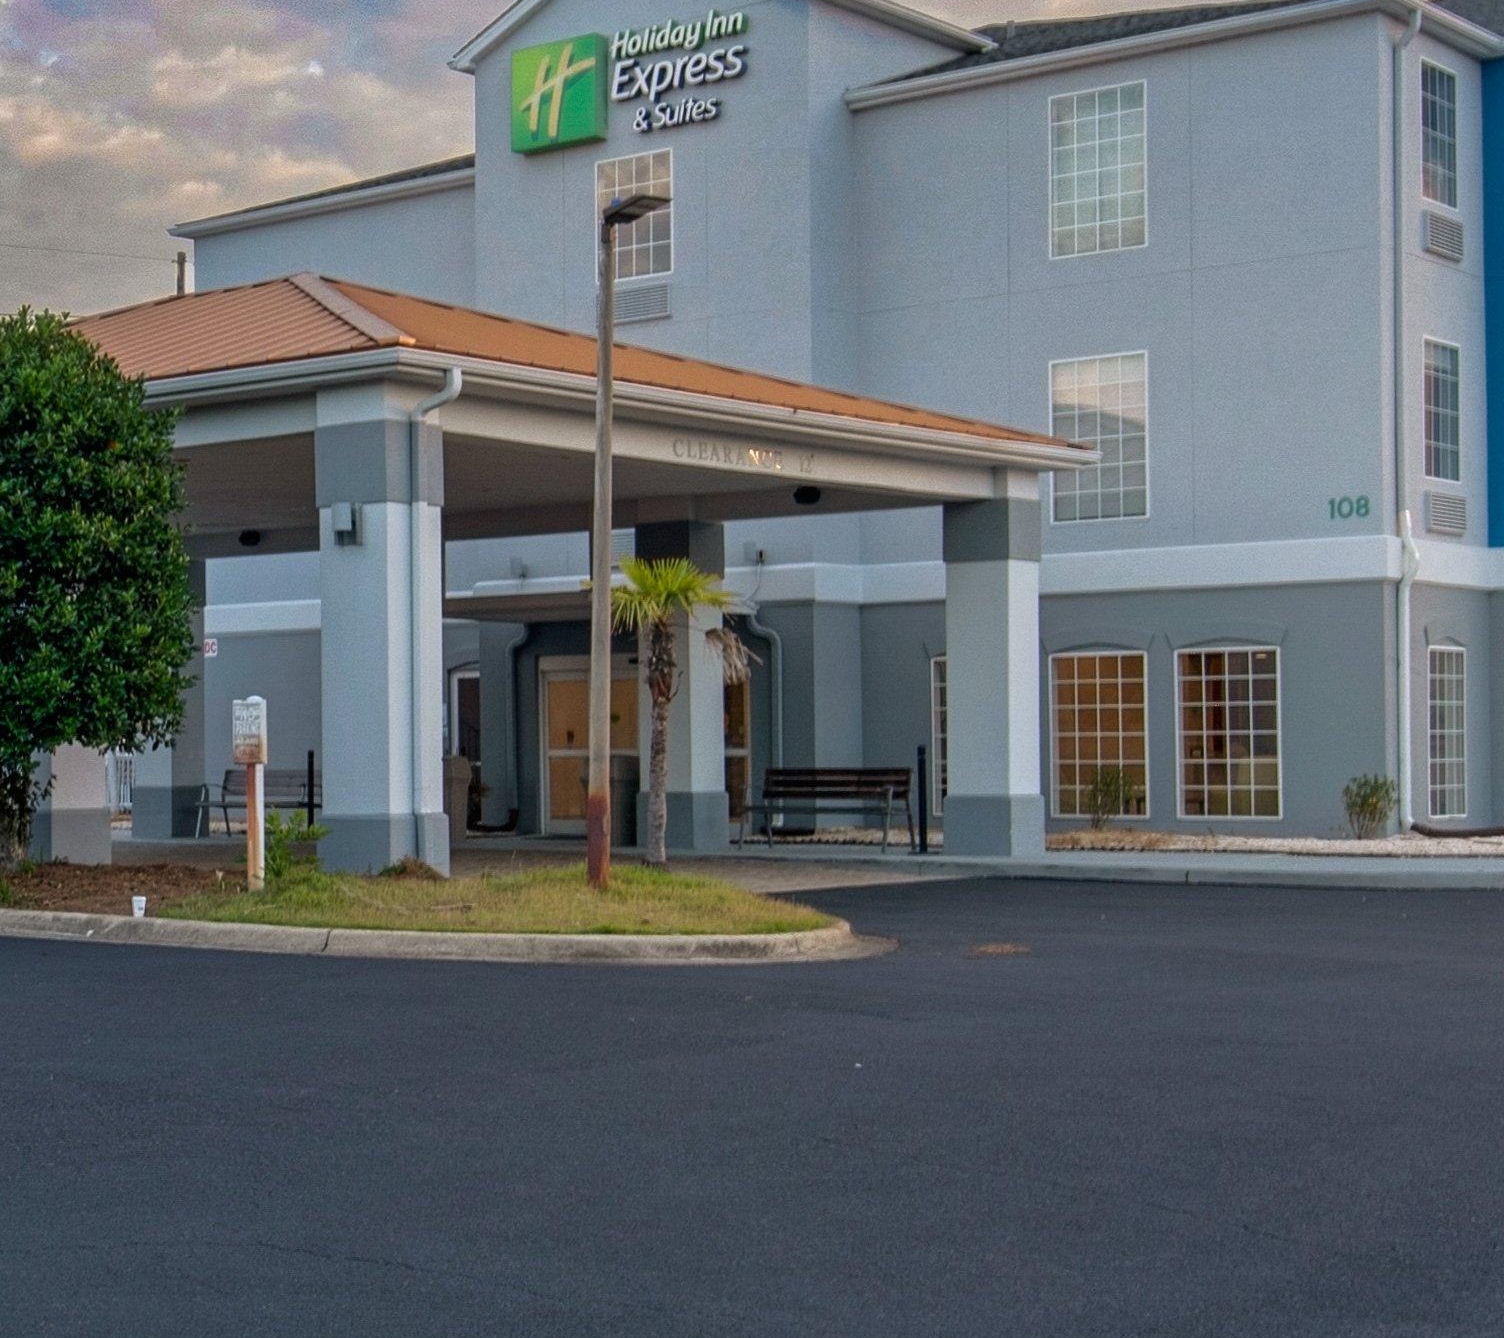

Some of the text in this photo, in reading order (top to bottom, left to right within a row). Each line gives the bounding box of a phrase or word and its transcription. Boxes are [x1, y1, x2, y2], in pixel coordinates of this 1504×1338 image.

[611, 9, 744, 58] Holiday Inn
[610, 45, 745, 101] Express
[633, 97, 717, 131] & Suites
[673, 439, 783, 470] CLEARANCE
[1328, 495, 1369, 519] 108
